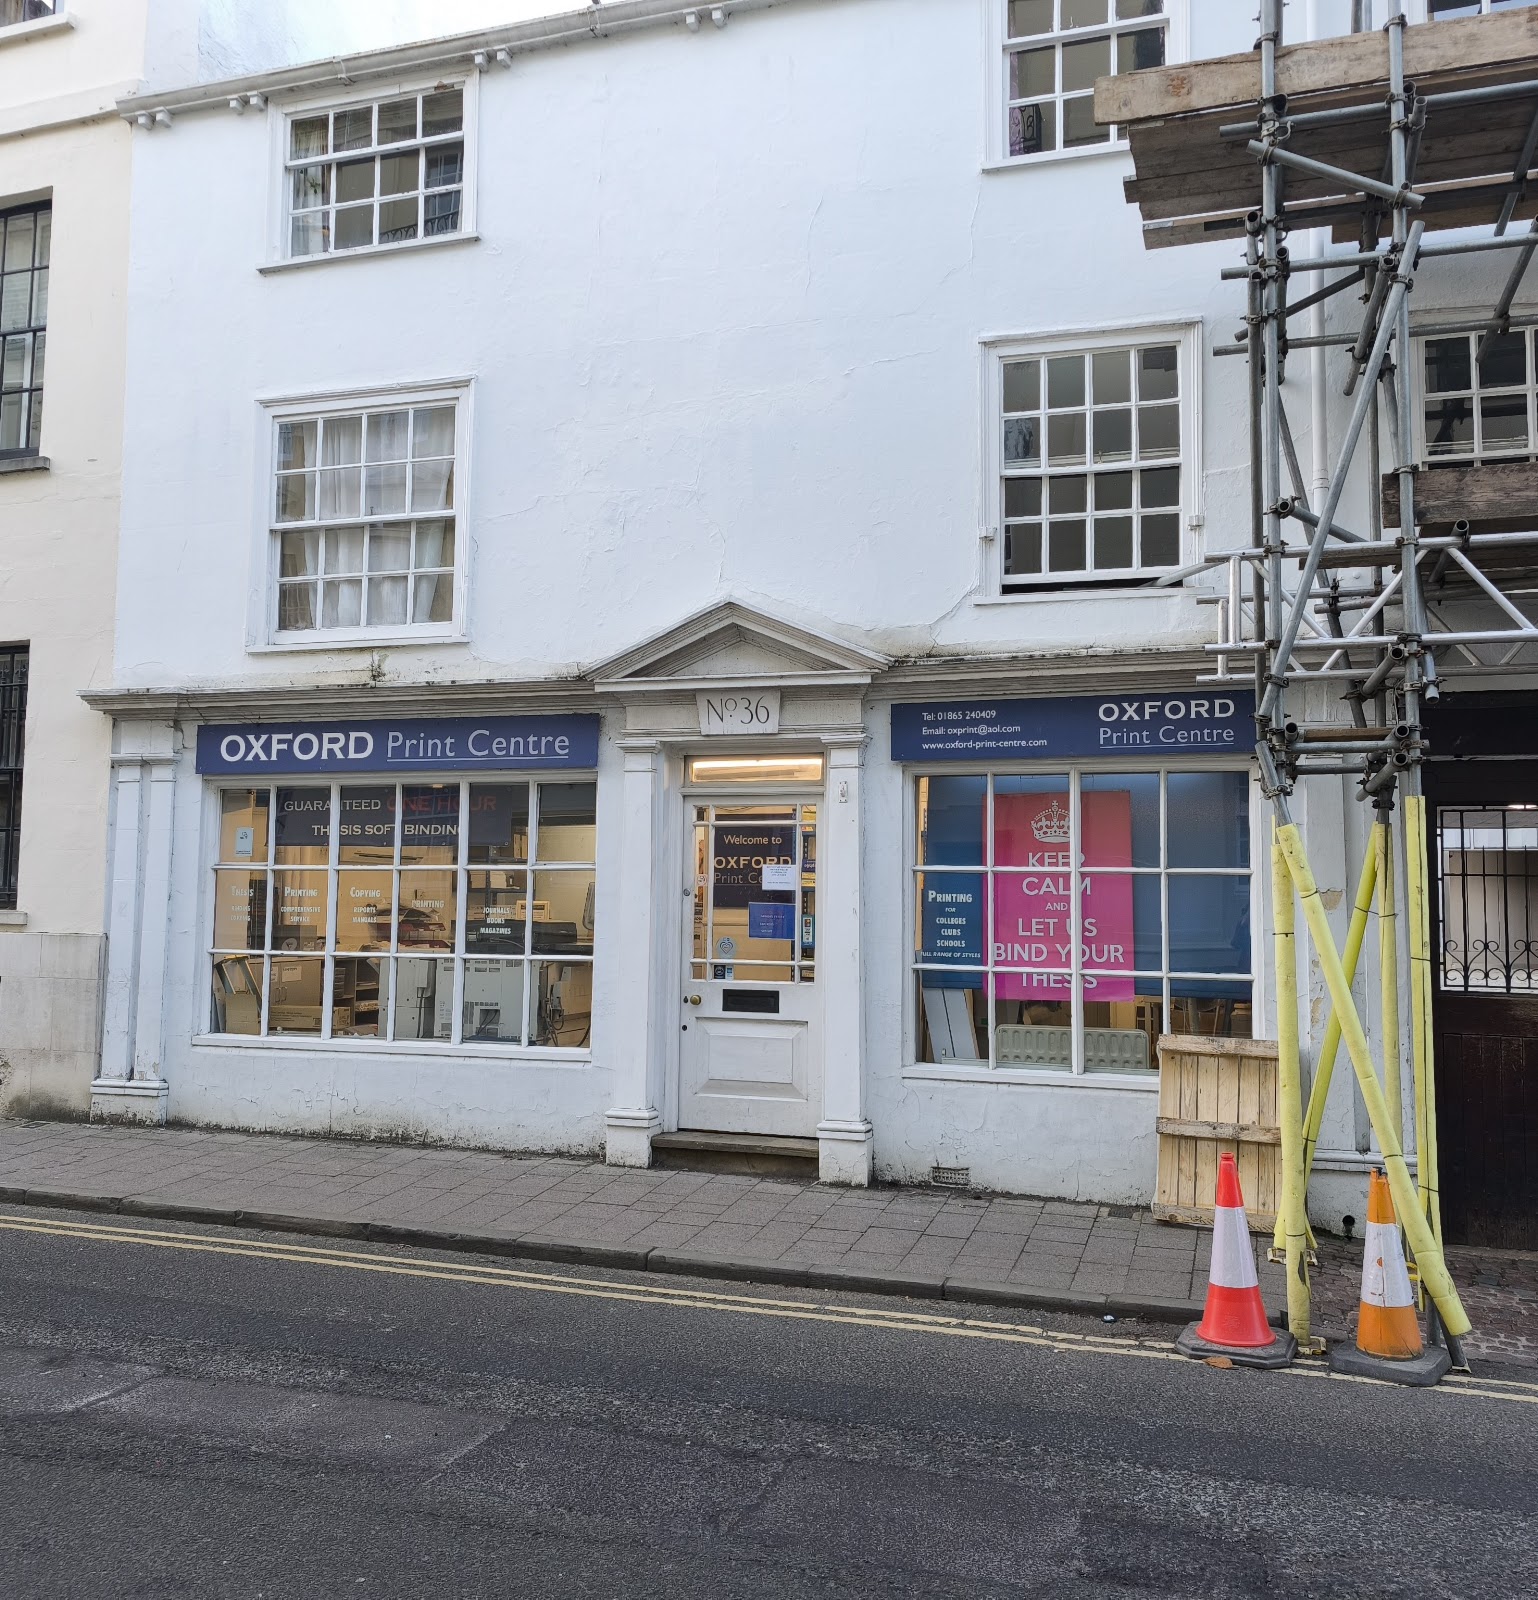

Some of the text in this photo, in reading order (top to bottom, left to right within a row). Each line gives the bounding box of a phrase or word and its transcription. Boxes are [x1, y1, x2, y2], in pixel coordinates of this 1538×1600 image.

[922, 710, 996, 721] Tel: 01865 240409
[1098, 699, 1235, 722] OXFORD
[922, 724, 1021, 736] Email: oxprint@aol.com
[1099, 725, 1234, 744] Print Centre
[220, 729, 569, 762] OXFORD Print Centre
[922, 739, 1048, 750] www.oxford-print-centre.com
[284, 800, 381, 811] GUARATEED
[311, 824, 361, 836] THSIS
[404, 824, 460, 835] BINDIN
[723, 834, 782, 845] Welcome to
[714, 872, 743, 884] Print
[928, 890, 973, 903] PRINTING
[1045, 902, 1068, 911] AND
[936, 917, 966, 925] COLLEGES
[941, 928, 961, 936] CLUBS
[1018, 918, 1058, 937] LET
[993, 943, 1047, 962] BIND
